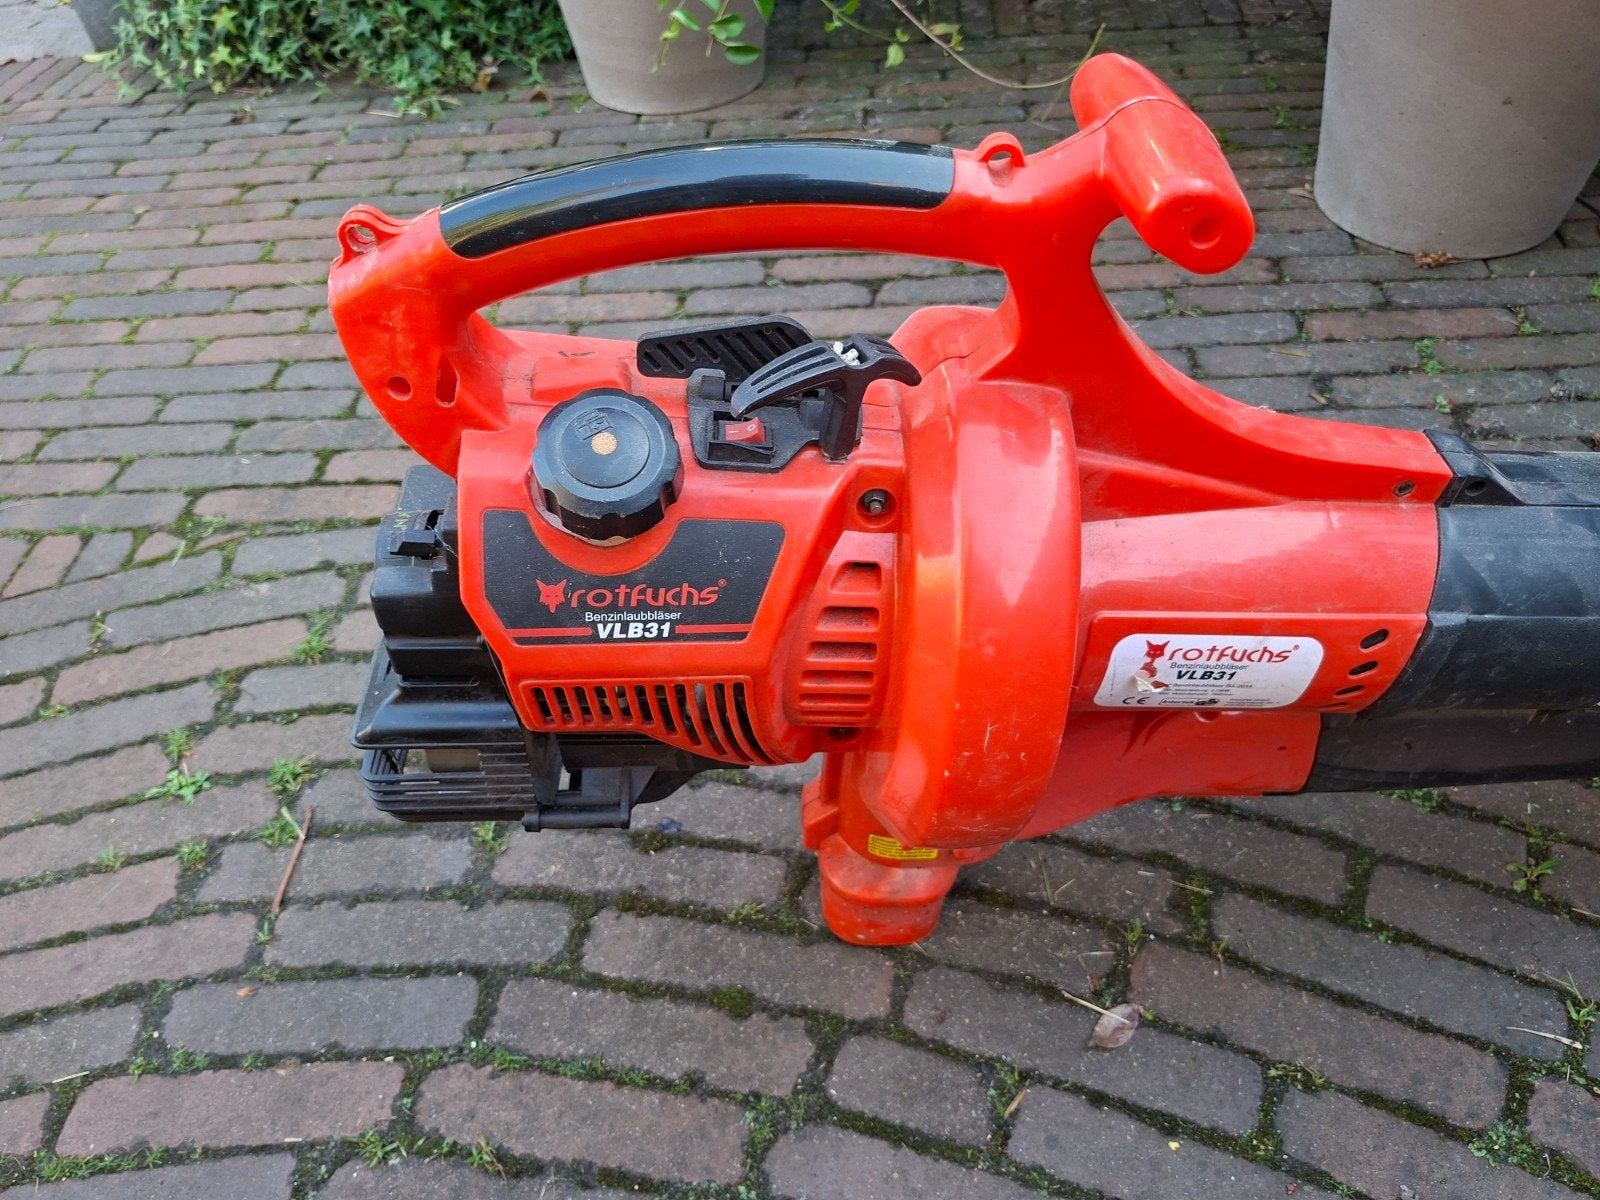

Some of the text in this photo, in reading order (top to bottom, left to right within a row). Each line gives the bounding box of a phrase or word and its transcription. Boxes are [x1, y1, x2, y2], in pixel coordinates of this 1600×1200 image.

[585, 611, 682, 622] Benzinlaubbläser
[597, 622, 671, 639] VLB31
[1175, 670, 1237, 681] VLB31
